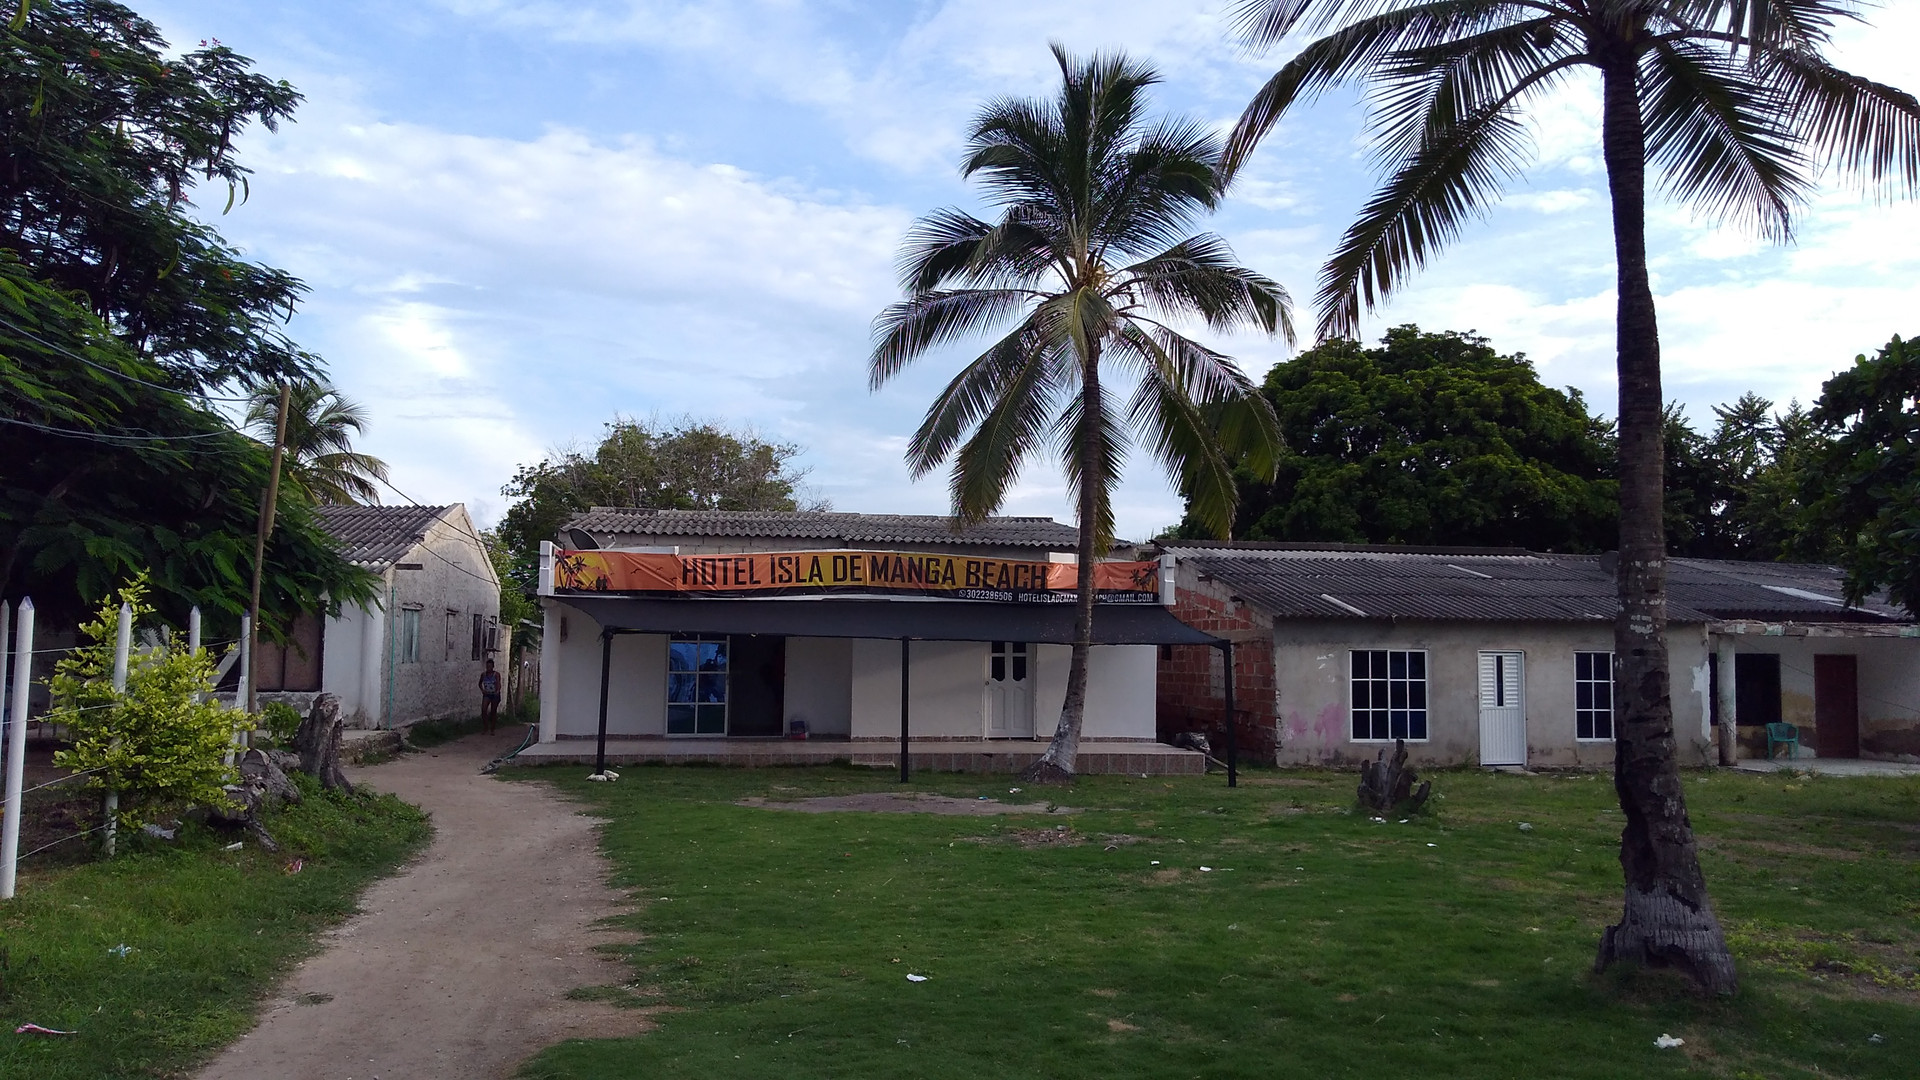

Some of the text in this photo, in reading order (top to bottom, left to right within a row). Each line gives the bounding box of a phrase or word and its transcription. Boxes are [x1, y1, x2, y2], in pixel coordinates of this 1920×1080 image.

[682, 555, 1047, 590] HOTEL ISLA DE MANGA BEACH
